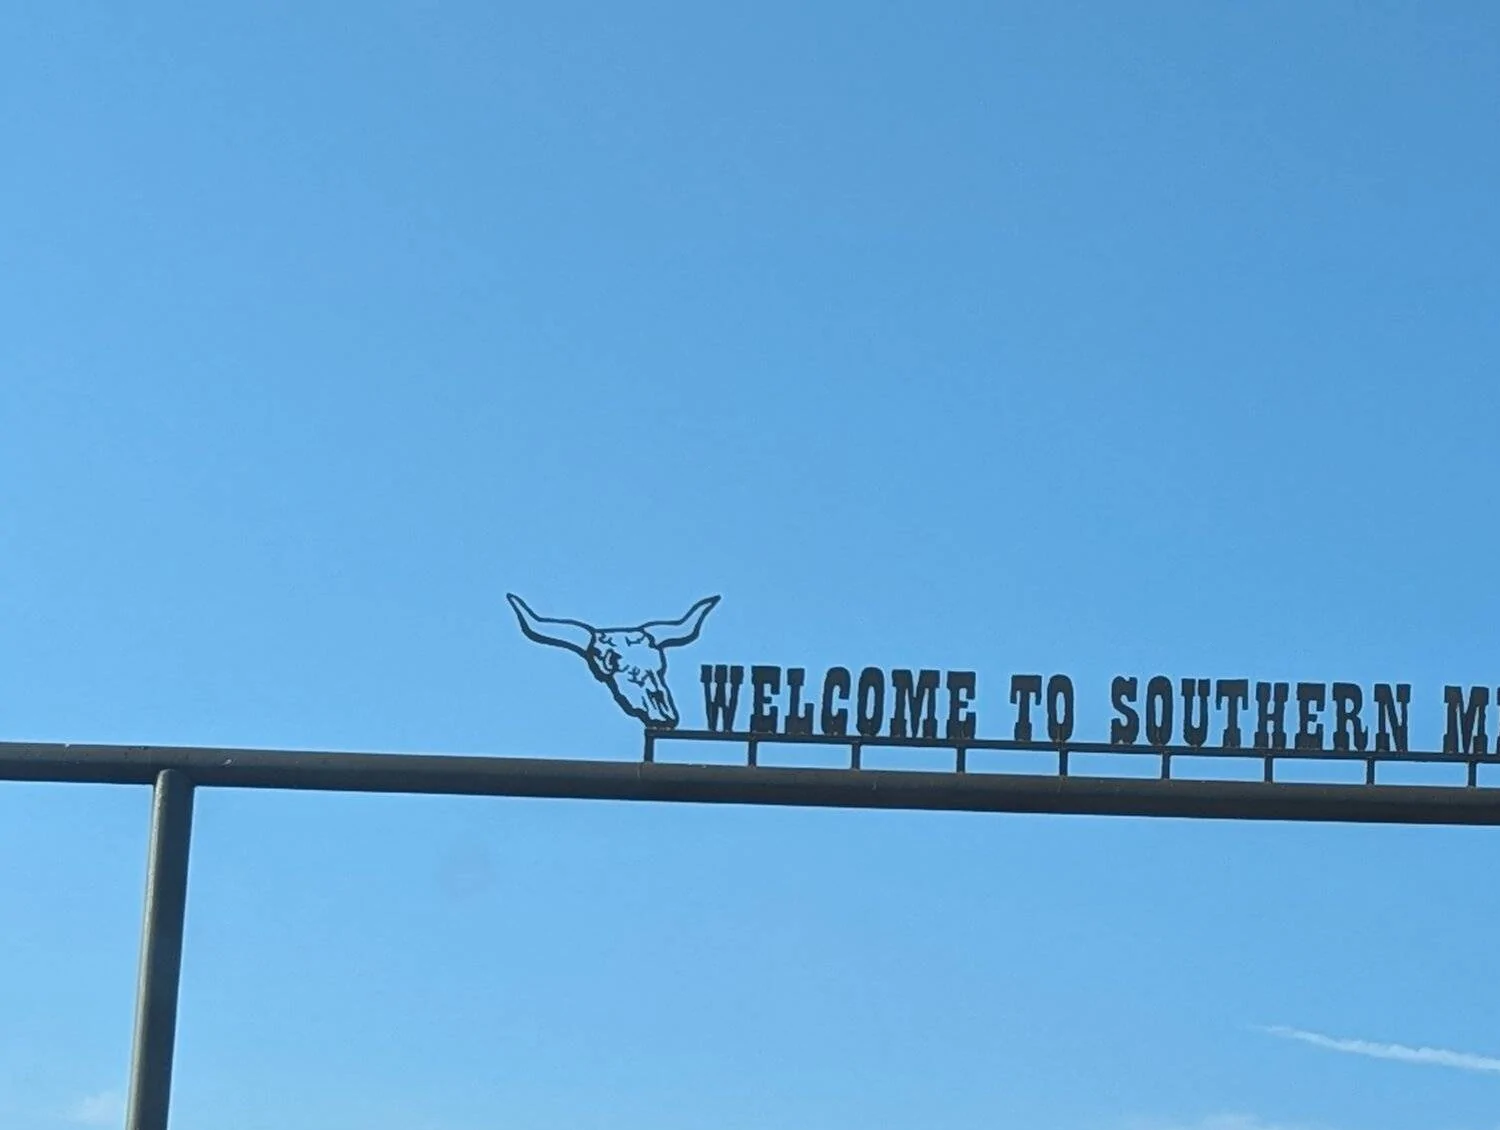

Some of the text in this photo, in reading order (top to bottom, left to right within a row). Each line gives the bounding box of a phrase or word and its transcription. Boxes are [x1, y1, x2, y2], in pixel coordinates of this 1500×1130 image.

[700, 666, 976, 740] WELCOME
[1010, 674, 1074, 742] TO
[1111, 676, 1411, 750] SOUTHERN
